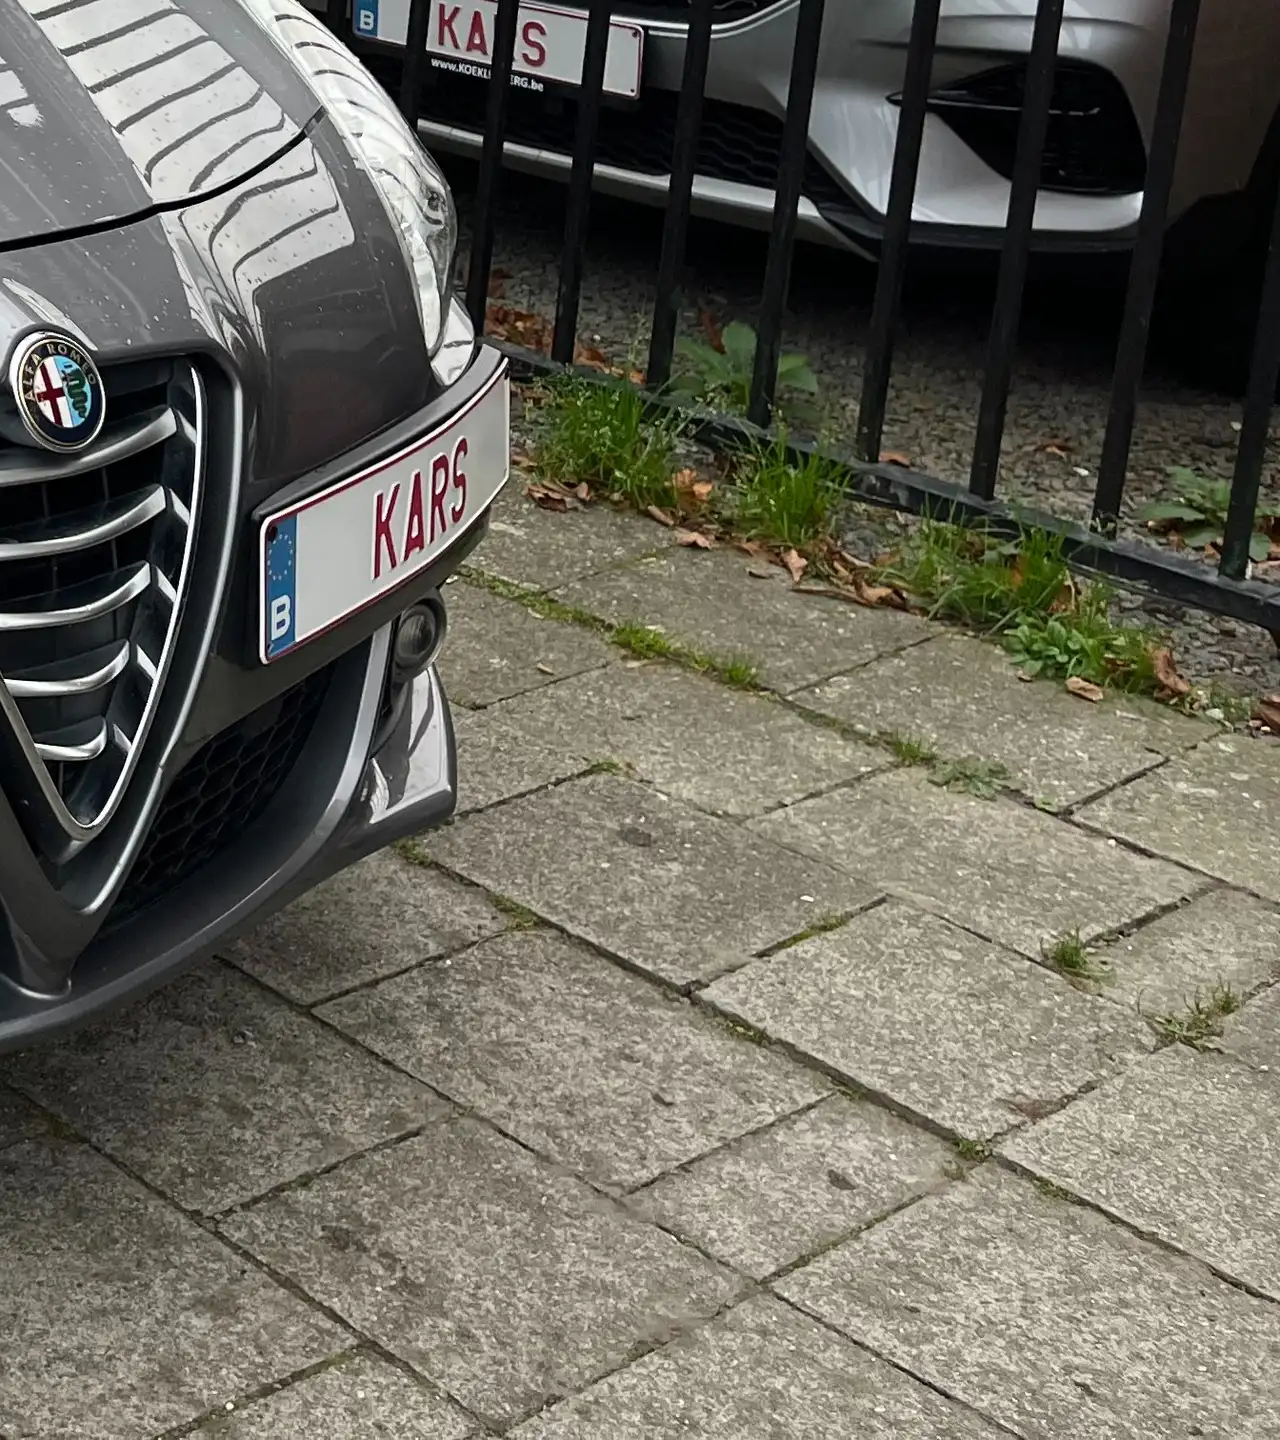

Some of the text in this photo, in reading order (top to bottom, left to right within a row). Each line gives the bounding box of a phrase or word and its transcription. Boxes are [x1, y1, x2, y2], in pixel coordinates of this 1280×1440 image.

[359, 3, 547, 68] B KAS
[23, 343, 97, 401] ALFA ROMEO
[270, 436, 469, 642] B KARS
